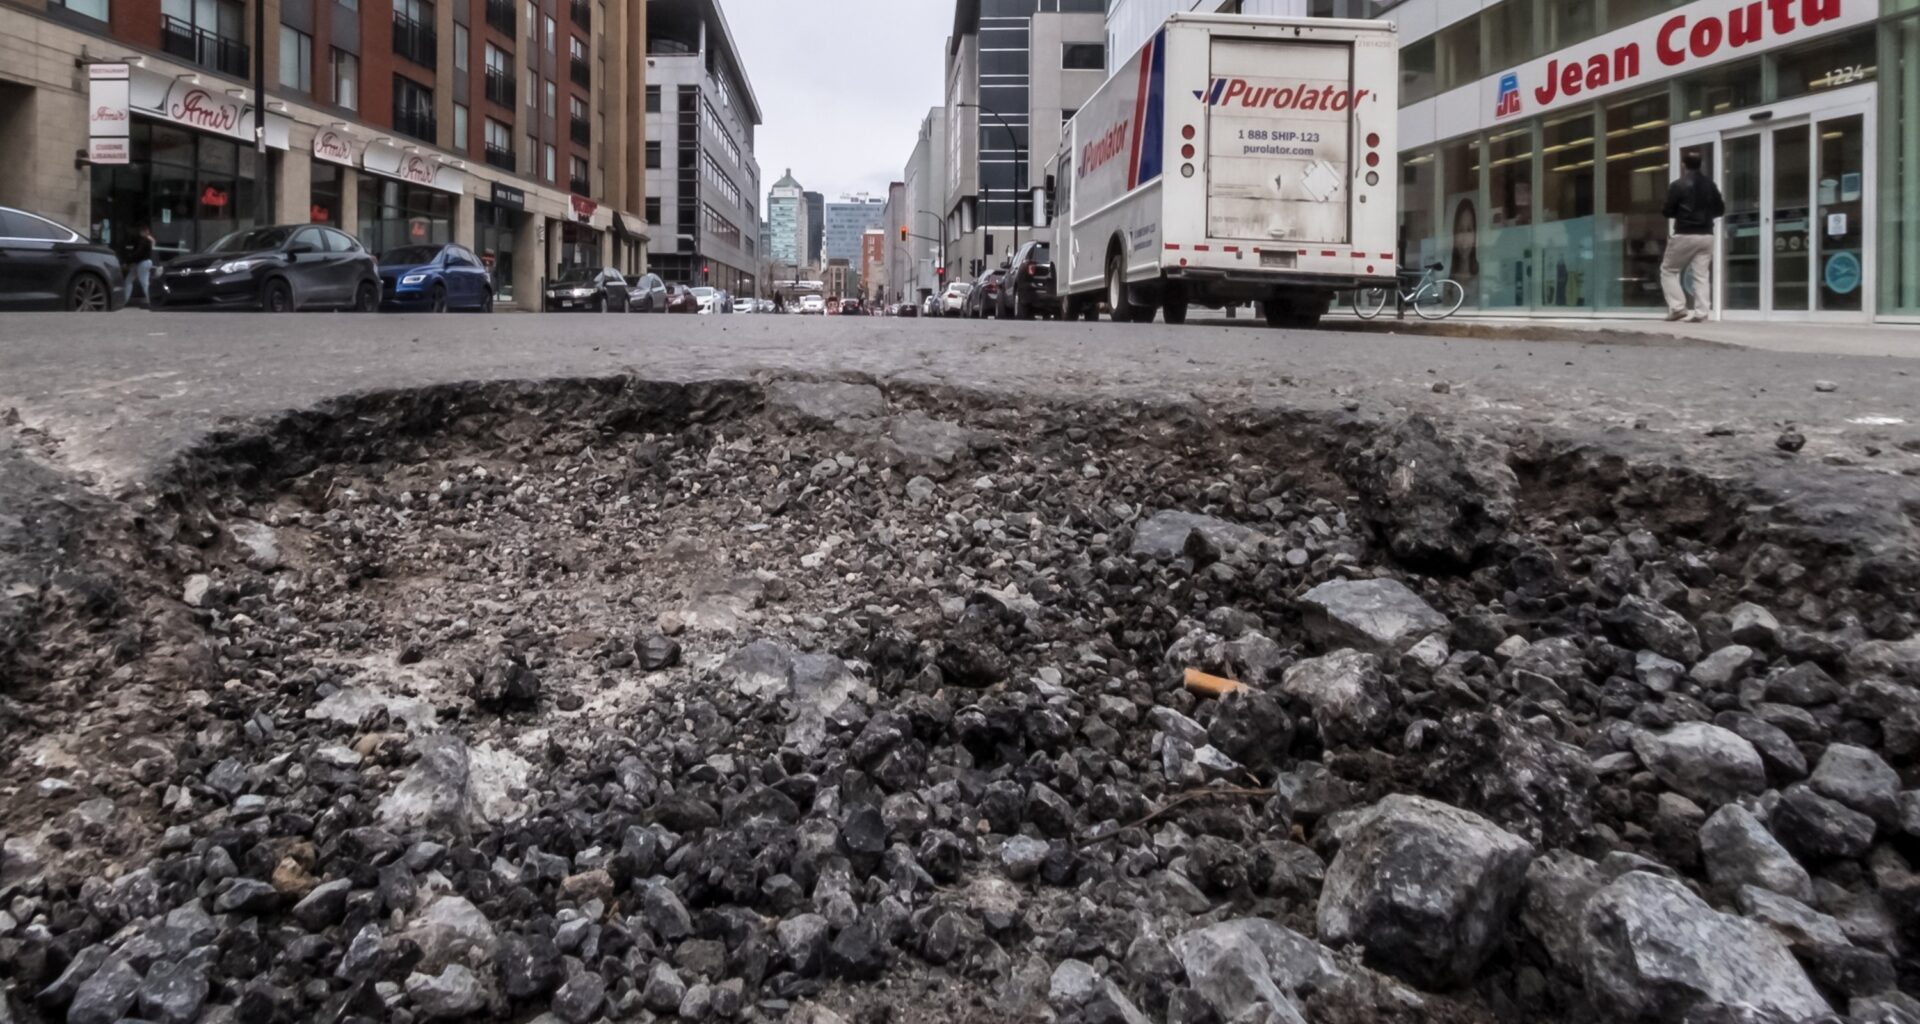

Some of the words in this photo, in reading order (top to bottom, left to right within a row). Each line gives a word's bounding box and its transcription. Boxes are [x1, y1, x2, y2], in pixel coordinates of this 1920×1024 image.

[1535, 42, 1640, 105] Jean
[1825, 64, 1864, 86] 1224
[172, 89, 238, 130] Amir
[1222, 78, 1370, 112] Purolator
[1085, 118, 1130, 176] Purolator
[1238, 130, 1245, 140] 1
[1248, 130, 1268, 141] 888
[1271, 131, 1320, 143] SHIP-123
[1243, 144, 1314, 156] purolator.com
